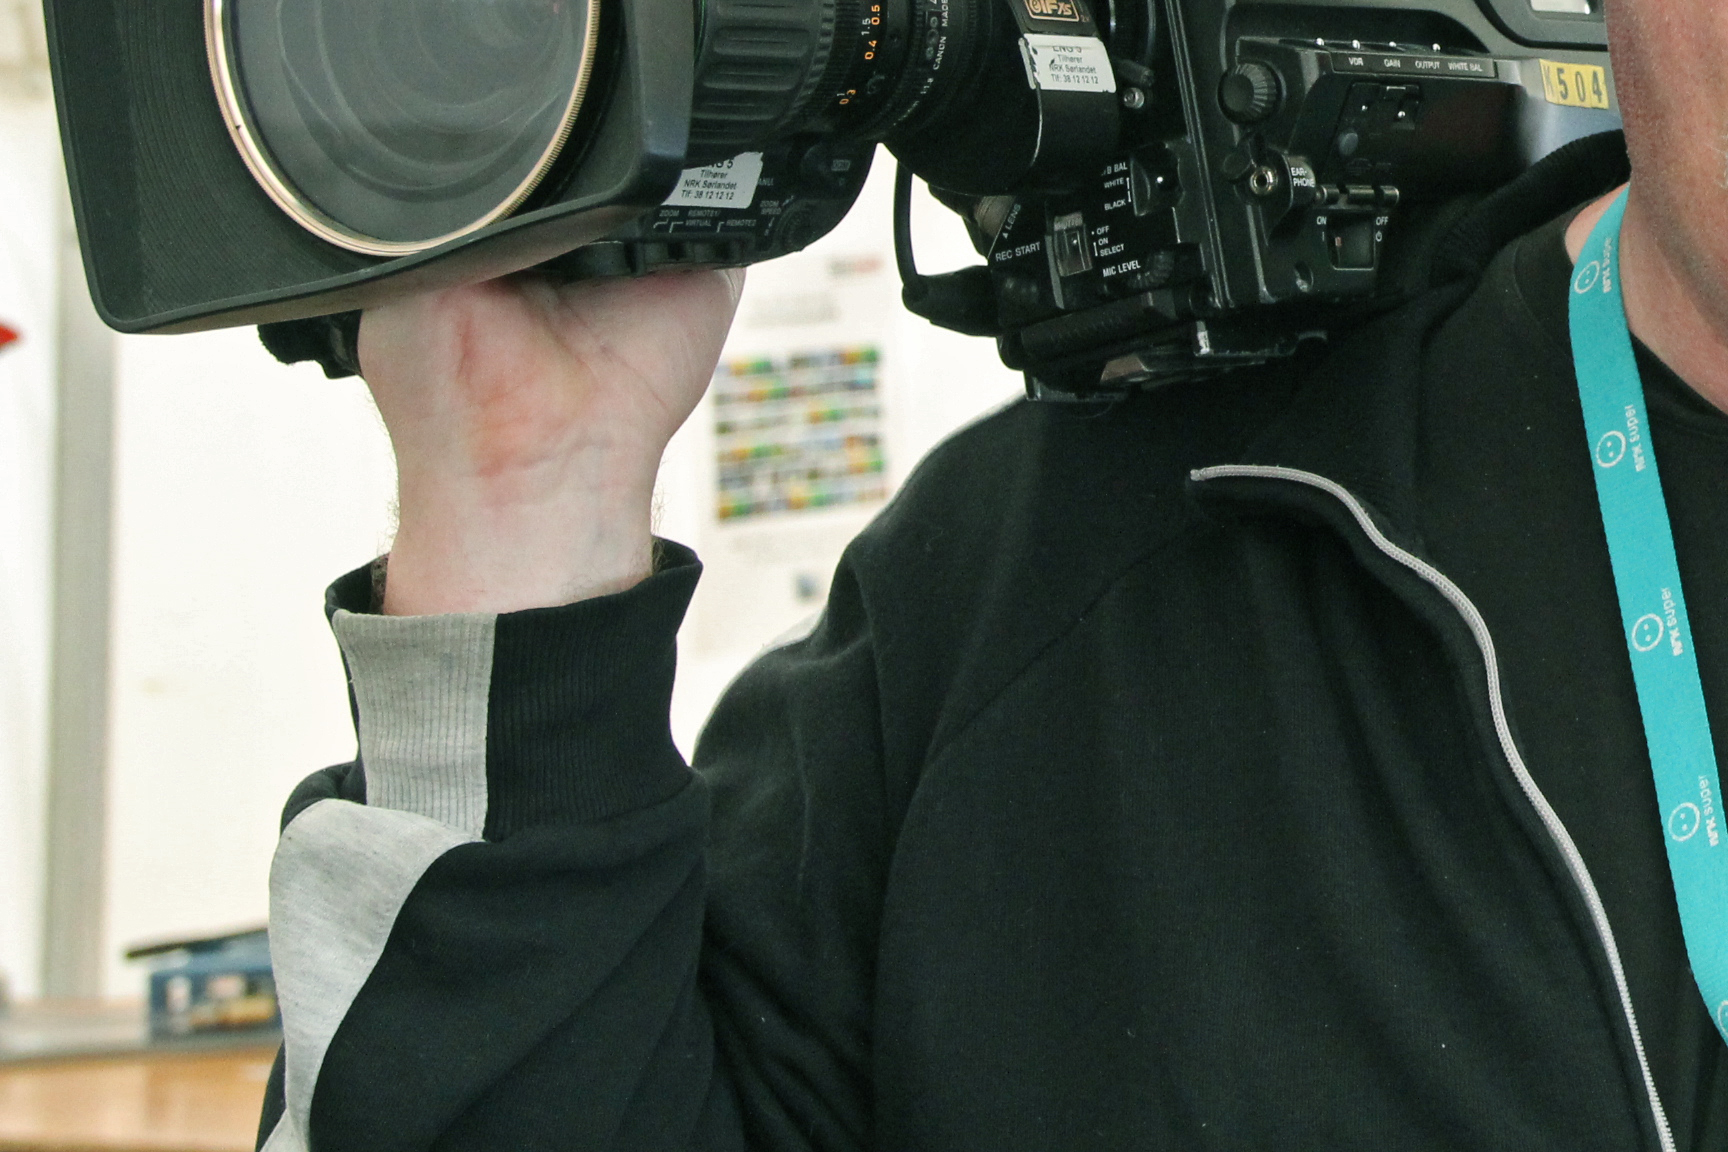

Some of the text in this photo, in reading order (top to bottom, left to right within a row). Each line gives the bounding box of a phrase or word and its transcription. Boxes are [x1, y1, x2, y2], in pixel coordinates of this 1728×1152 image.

[871, 4, 881, 26] 0.5
[864, 40, 878, 60] 0.4
[933, 36, 948, 71] CANON
[1384, 58, 1401, 68] GAIN
[1415, 60, 1440, 70] OUTPUT
[1448, 62, 1468, 71] WHITE
[1073, 75, 1081, 84] 12
[1082, 76, 1089, 84] 12
[1091, 76, 1099, 84] 12
[1114, 161, 1128, 174] BAL
[684, 179, 701, 188] NRK
[1103, 177, 1124, 189] WHITE
[1293, 177, 1315, 188] PHONE
[694, 190, 703, 199] 38
[705, 191, 714, 199] 12
[715, 191, 724, 199] 12
[726, 191, 734, 200] 12
[1104, 199, 1126, 211] BLACK
[1005, 203, 1022, 231] LENS
[1316, 216, 1389, 226] ON OFF
[1096, 225, 1110, 236] OFF
[1098, 237, 1109, 245] ON
[995, 241, 1041, 262] REC START
[1099, 243, 1125, 257] SELECT
[1102, 259, 1141, 278] MIC LEVEL
